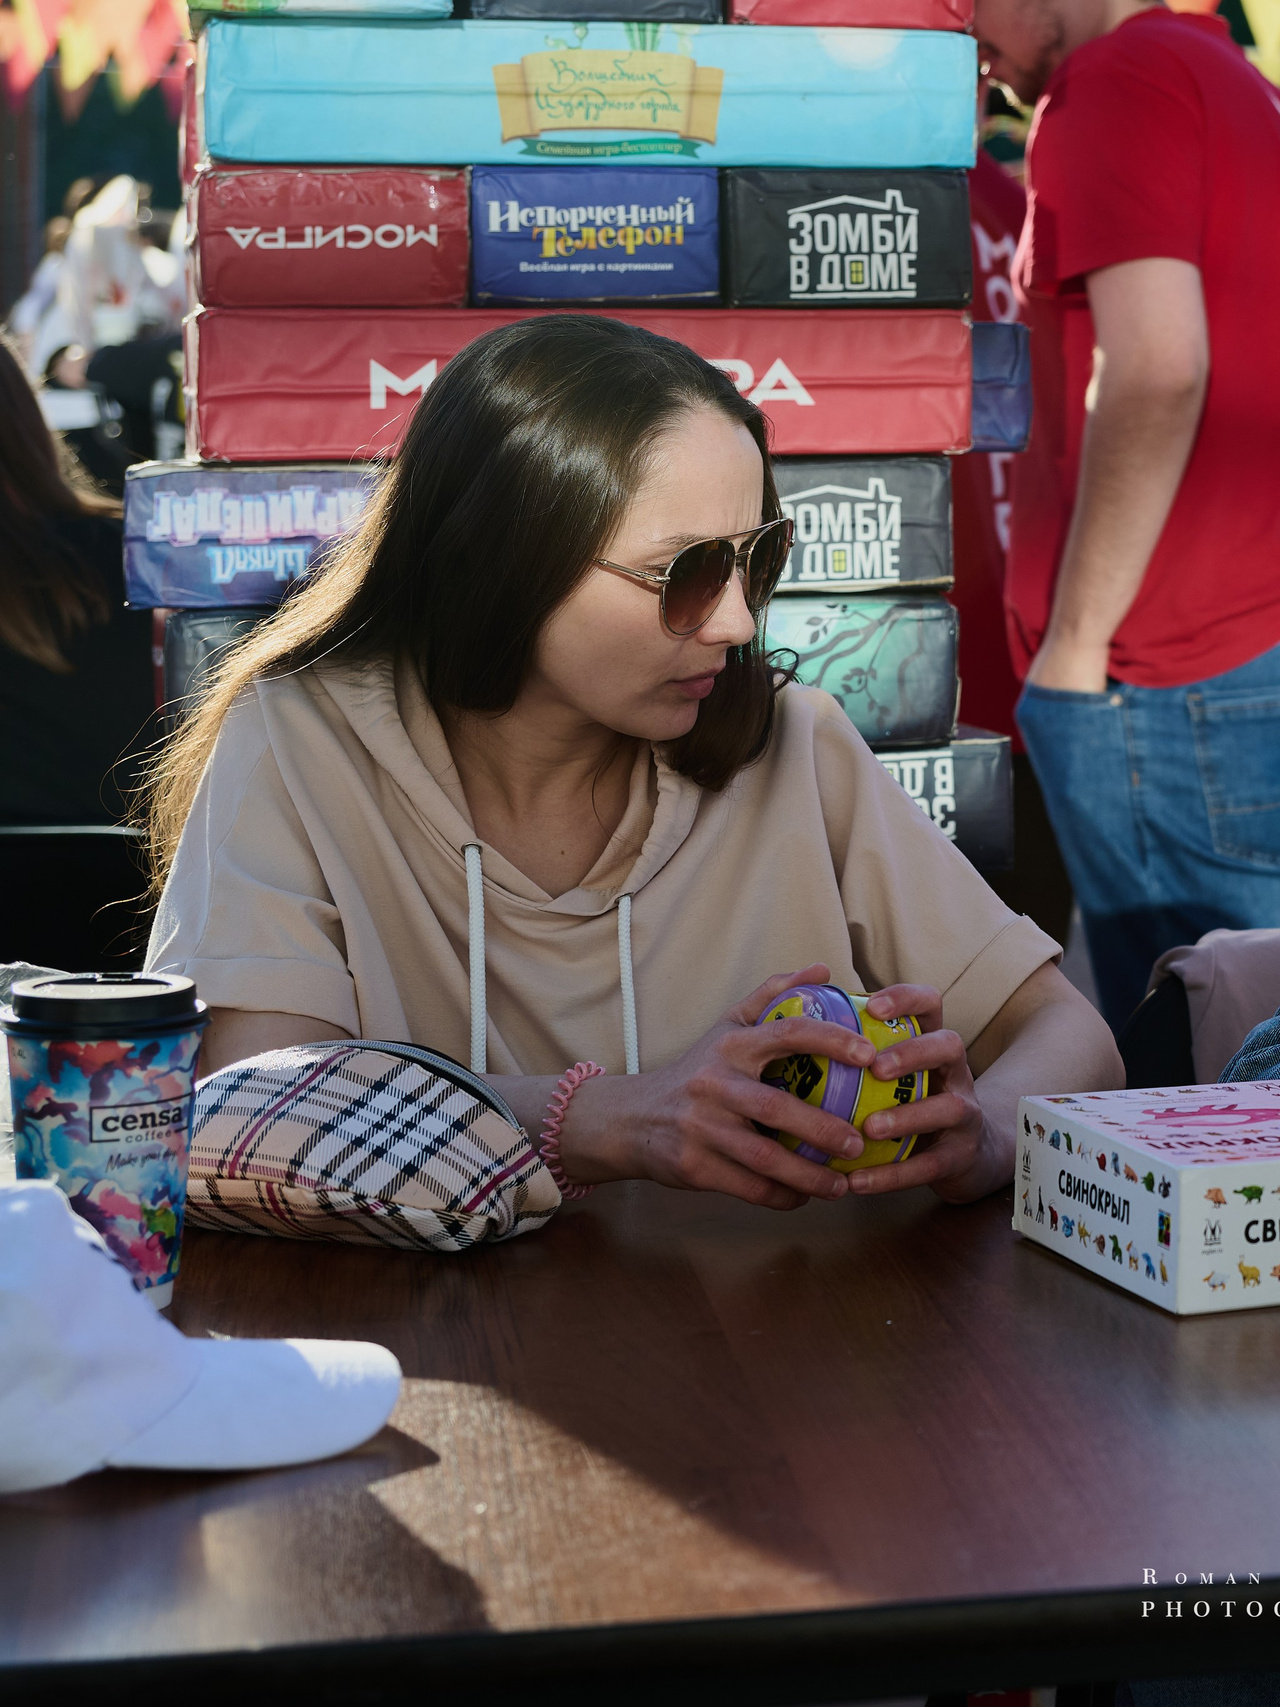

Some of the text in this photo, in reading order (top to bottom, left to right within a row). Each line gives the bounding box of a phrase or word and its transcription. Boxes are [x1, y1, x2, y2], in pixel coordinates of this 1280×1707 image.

[487, 196, 695, 233] Испорченный
[226, 224, 438, 250] МОСИГРА
[532, 225, 685, 258] Телефон
[788, 212, 918, 255] ЗОМБИ
[790, 254, 917, 292] В ДОМЕ
[798, 541, 900, 580] ДОМЕ
[101, 1106, 183, 1133] censa
[125, 1129, 172, 1143] coffee
[1058, 1169, 1130, 1226] СВИНОКРЫЛ
